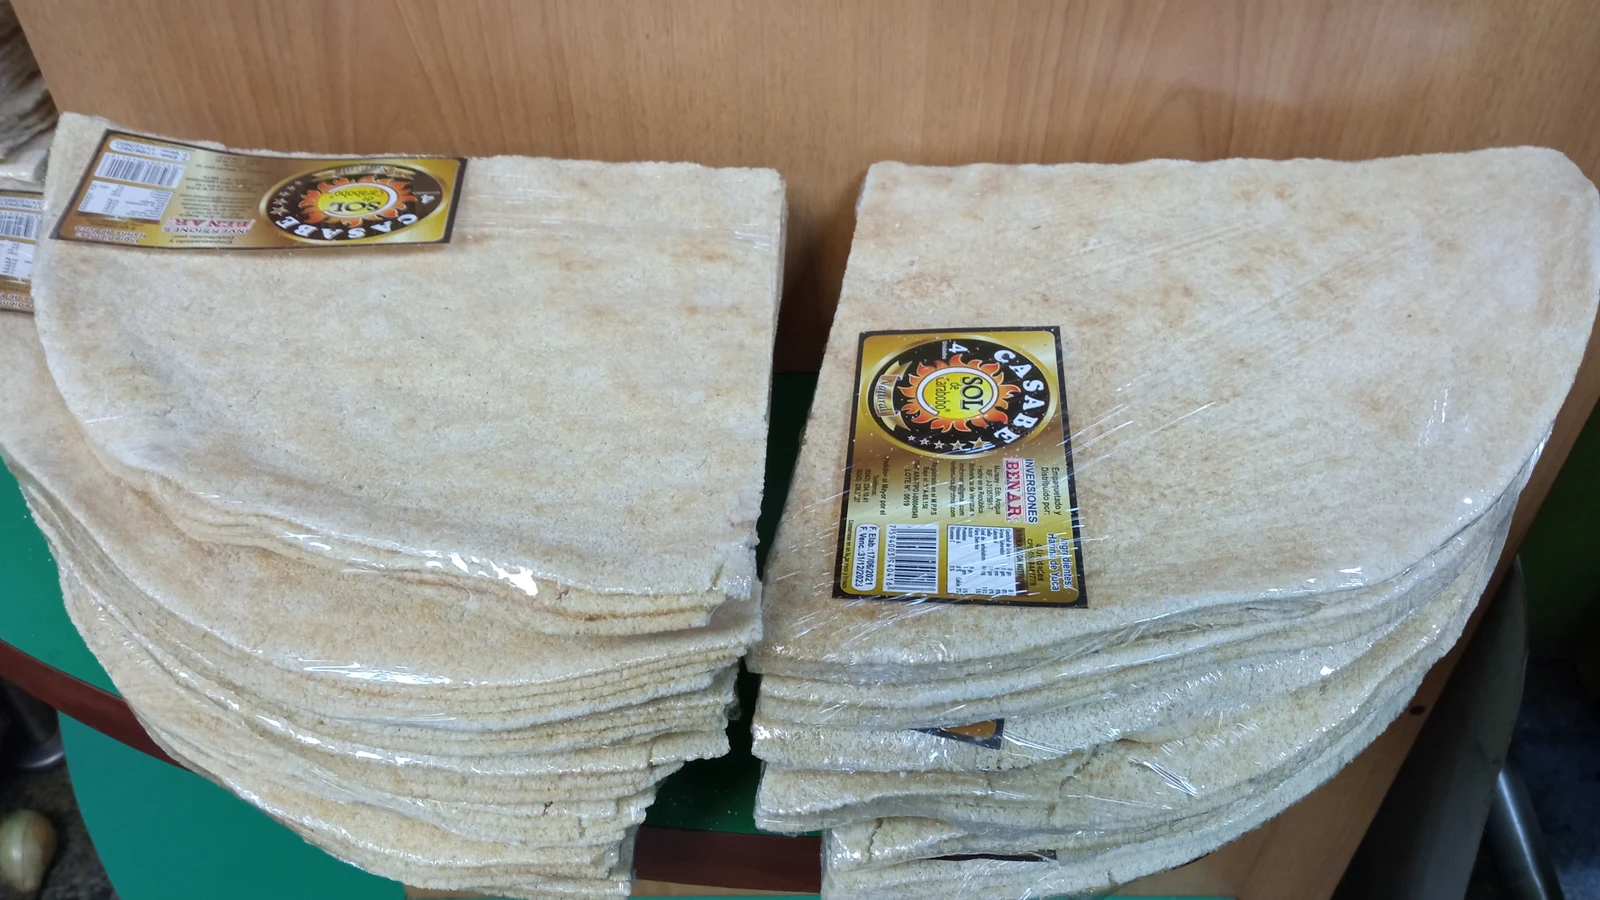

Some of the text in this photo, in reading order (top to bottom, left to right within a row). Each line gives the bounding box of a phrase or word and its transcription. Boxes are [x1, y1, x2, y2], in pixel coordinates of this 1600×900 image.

[329, 201, 380, 212] SOL
[421, 194, 435, 204] 4
[275, 214, 418, 240] CASABE
[948, 341, 968, 354] 4
[876, 379, 891, 412] Natural
[950, 382, 960, 390] de
[962, 376, 983, 410] SOL
[994, 350, 1045, 444] CASABE
[880, 484, 888, 499] Mayor
[1006, 460, 1022, 517] BENAR
[1025, 459, 1038, 523] INVERSIONES
[1041, 467, 1050, 515] Distribuido por:
[1051, 467, 1062, 510] Empaquetado
[888, 532, 896, 556] 594003
[1036, 550, 1044, 581] Undades
[1047, 533, 1060, 591] Harina de Yuca
